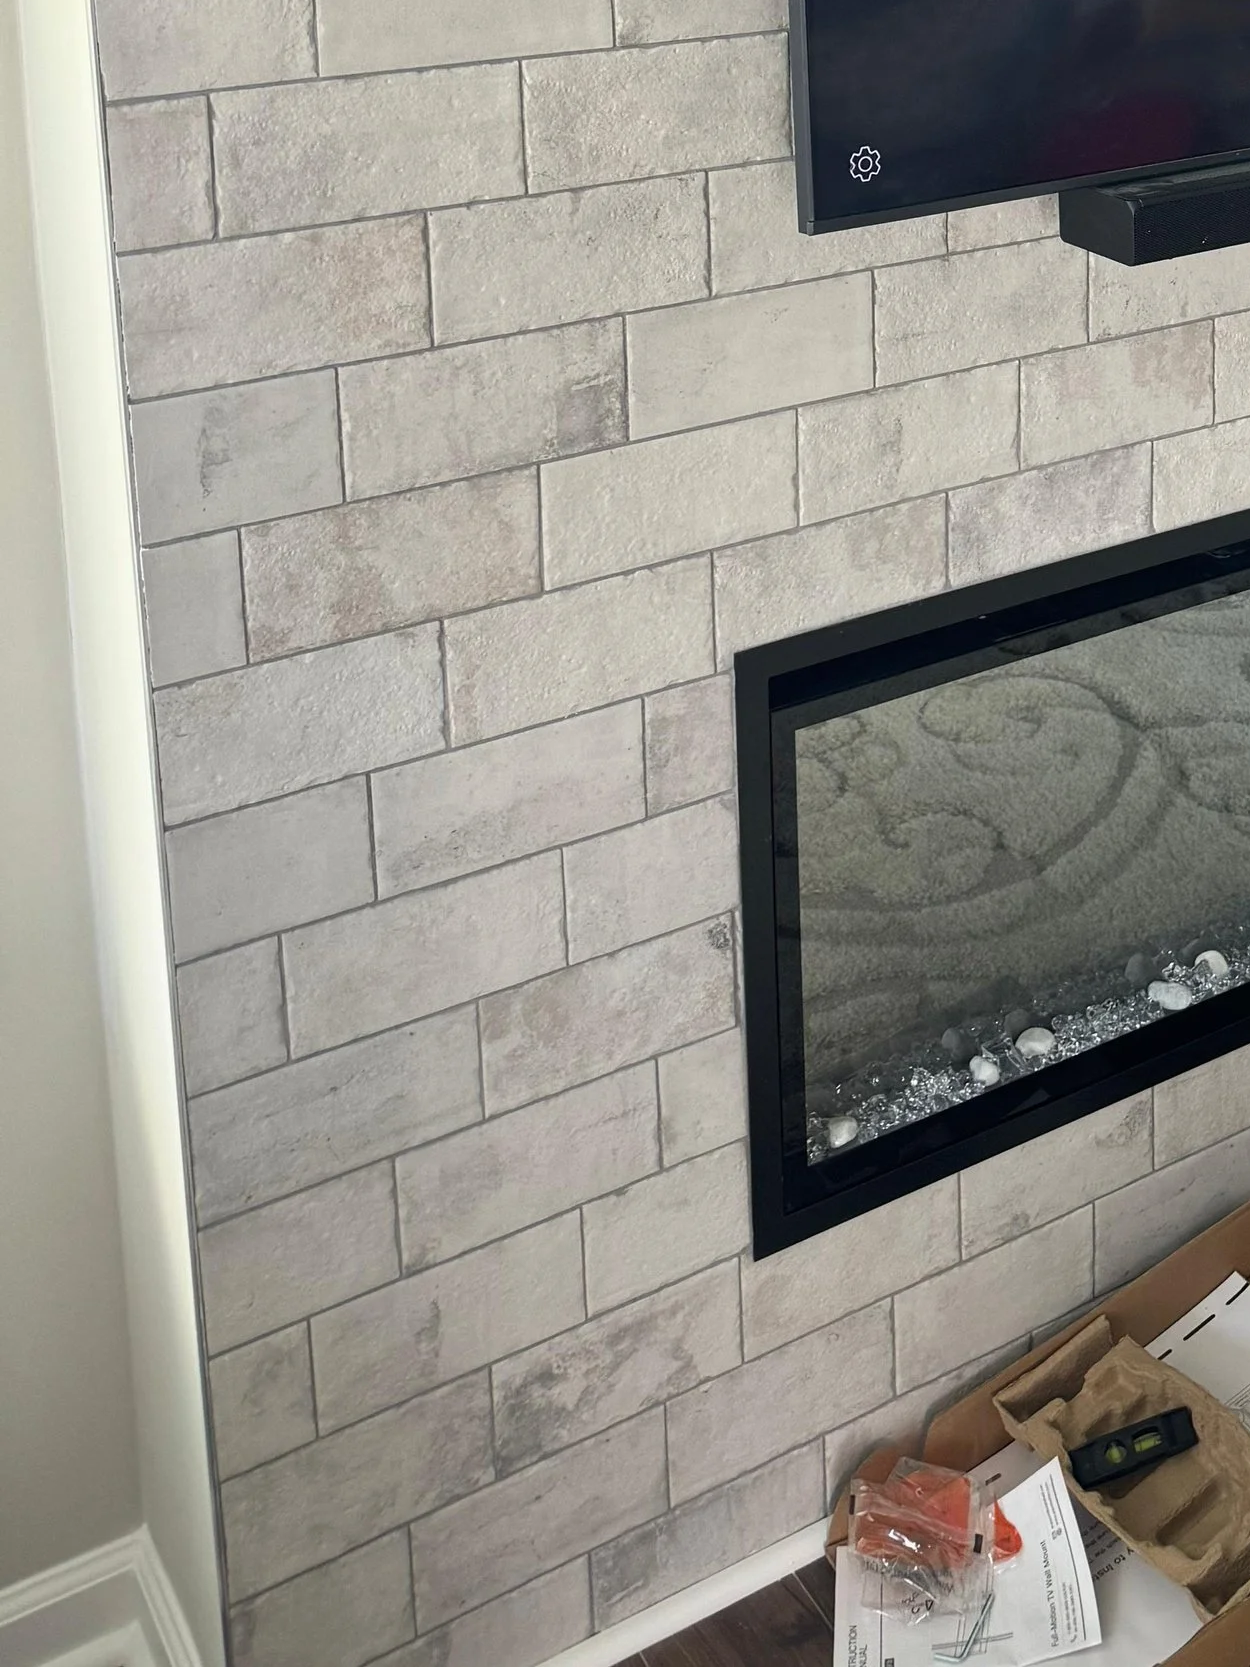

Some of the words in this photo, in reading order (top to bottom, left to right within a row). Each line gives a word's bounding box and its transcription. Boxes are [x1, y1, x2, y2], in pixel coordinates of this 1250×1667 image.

[1040, 1540, 1051, 1569] Mount
[1114, 1554, 1126, 1564] to
[1043, 1569, 1053, 1589] Wall
[1092, 1564, 1114, 1582] Inst
[1047, 1590, 1054, 1601] TV
